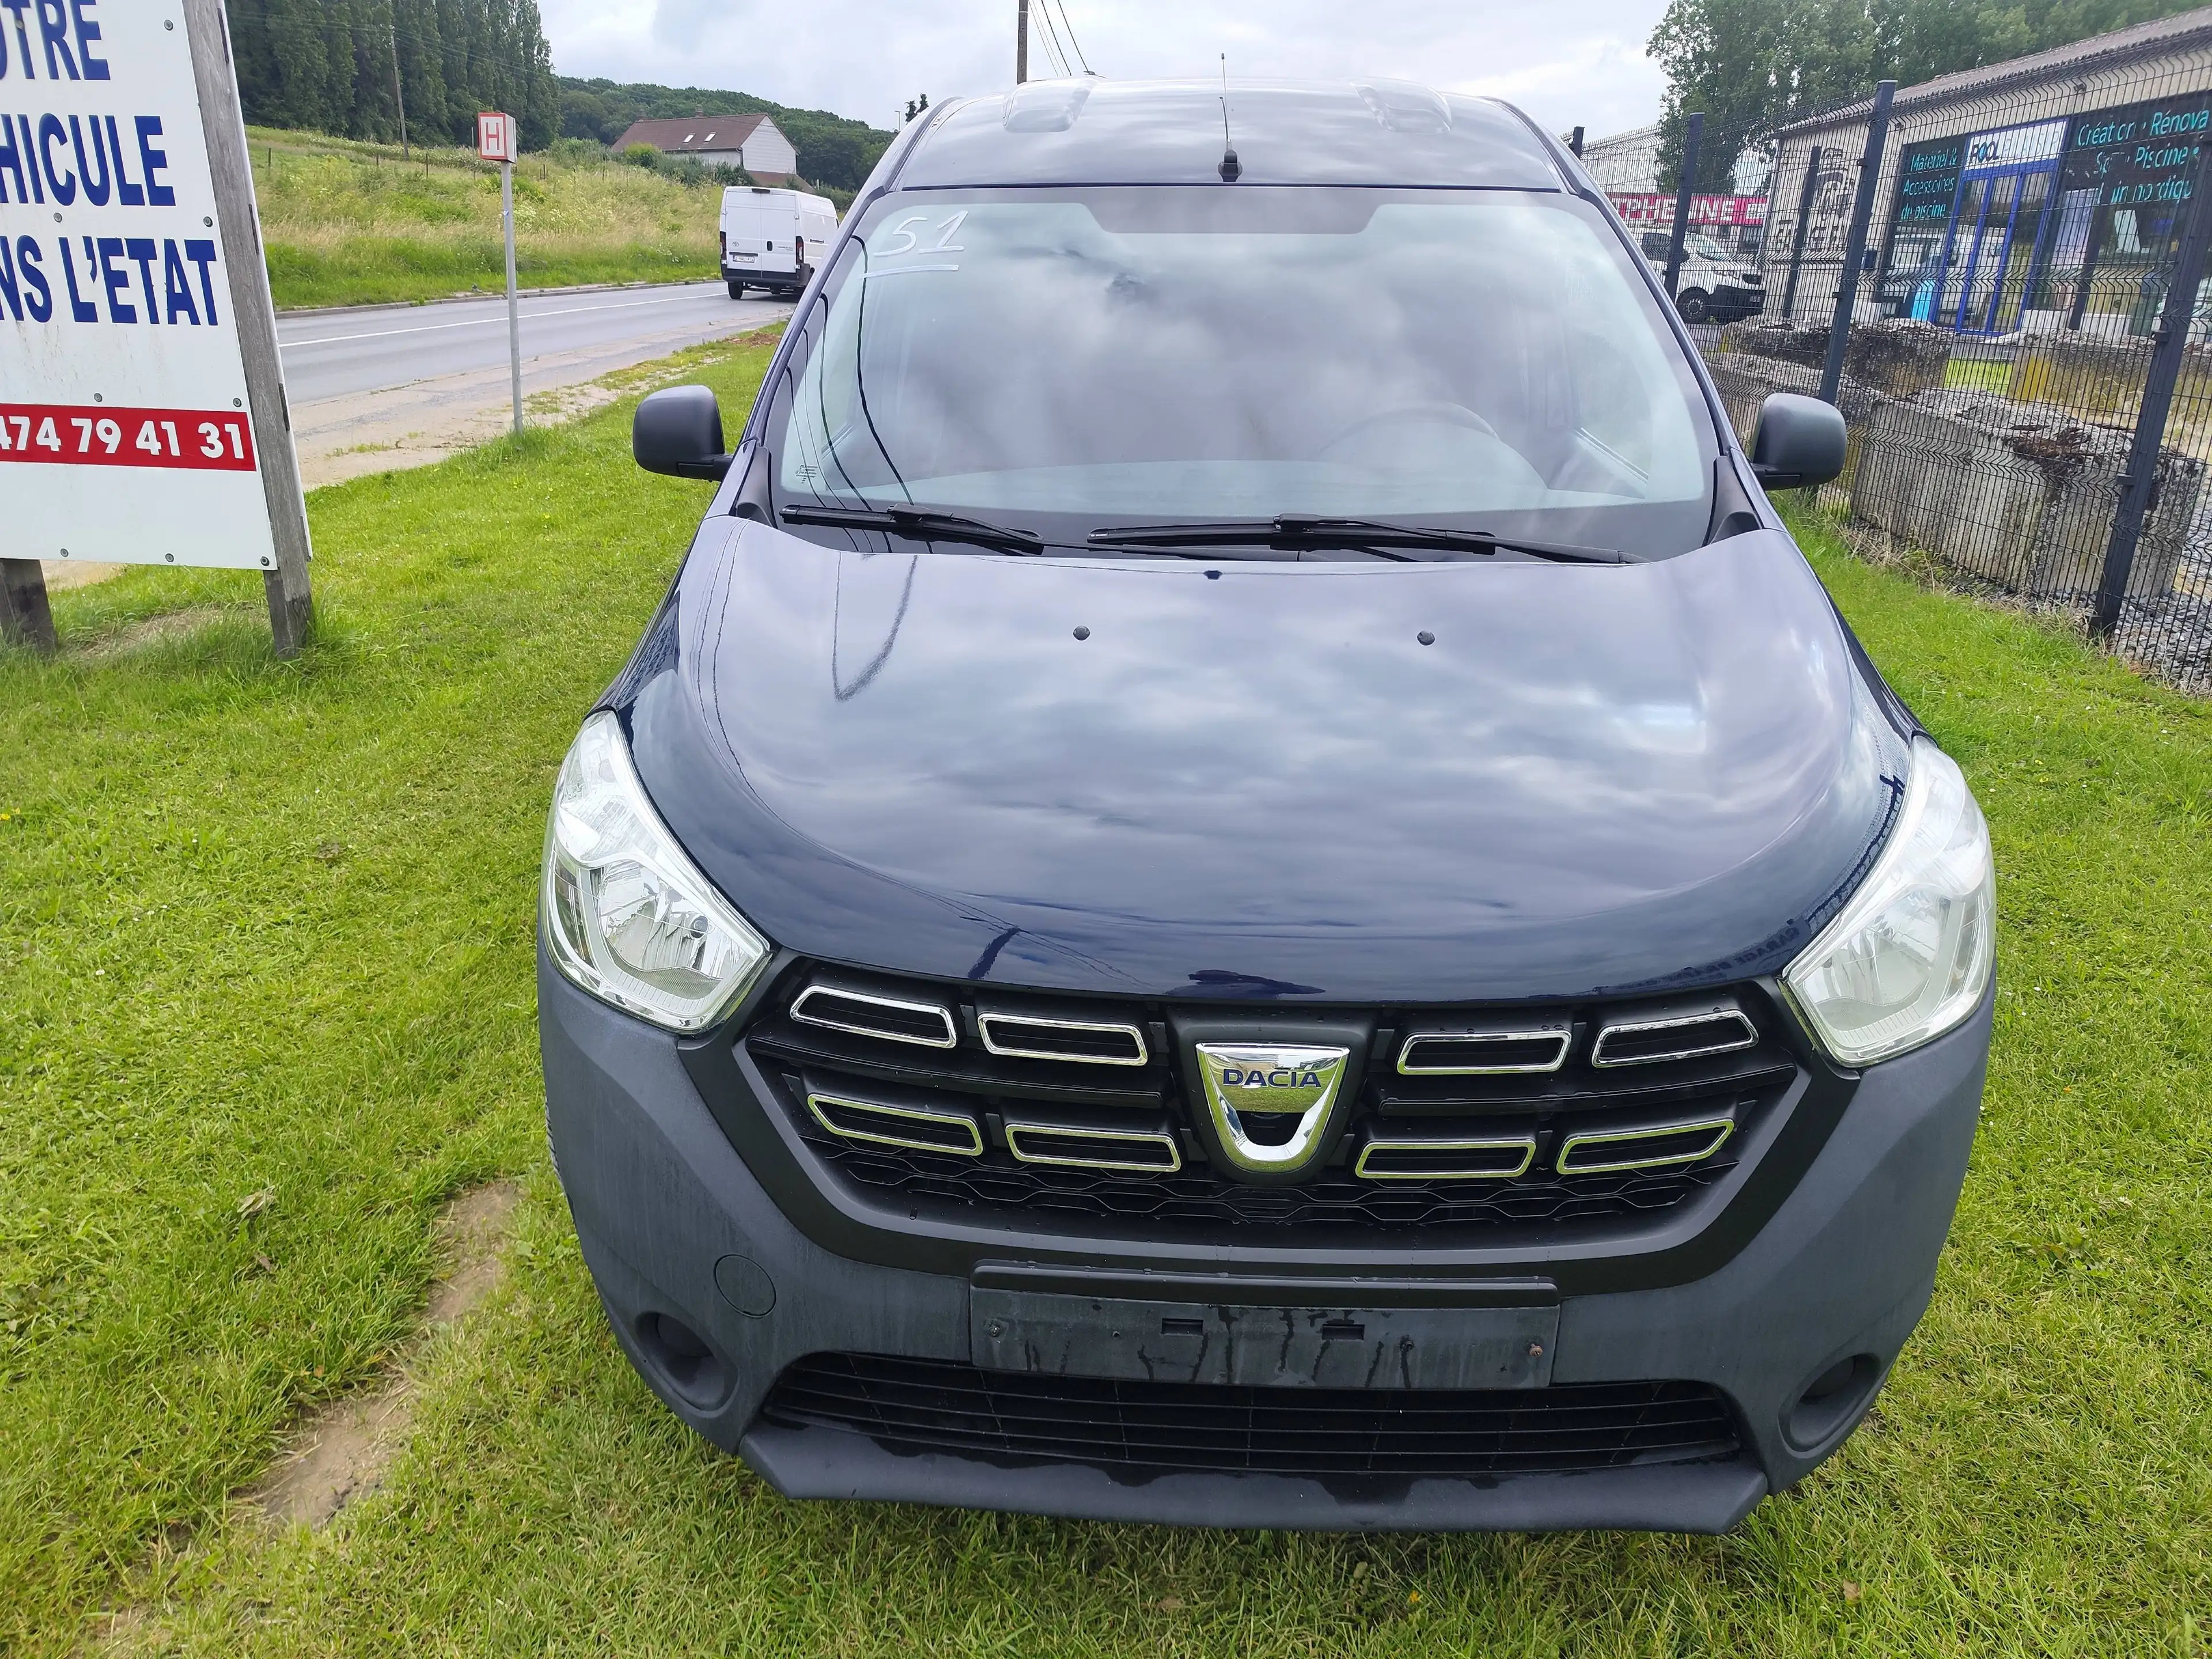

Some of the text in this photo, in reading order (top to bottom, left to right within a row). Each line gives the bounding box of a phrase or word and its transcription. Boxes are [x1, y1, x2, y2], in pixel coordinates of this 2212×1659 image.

[485, 122, 500, 150] H
[873, 210, 970, 257] 51
[58, 235, 218, 326] L'ETAT
[70, 418, 122, 454] 79
[135, 421, 181, 456] 41
[198, 422, 244, 459] 31
[1222, 1068, 1322, 1089] DACIA
